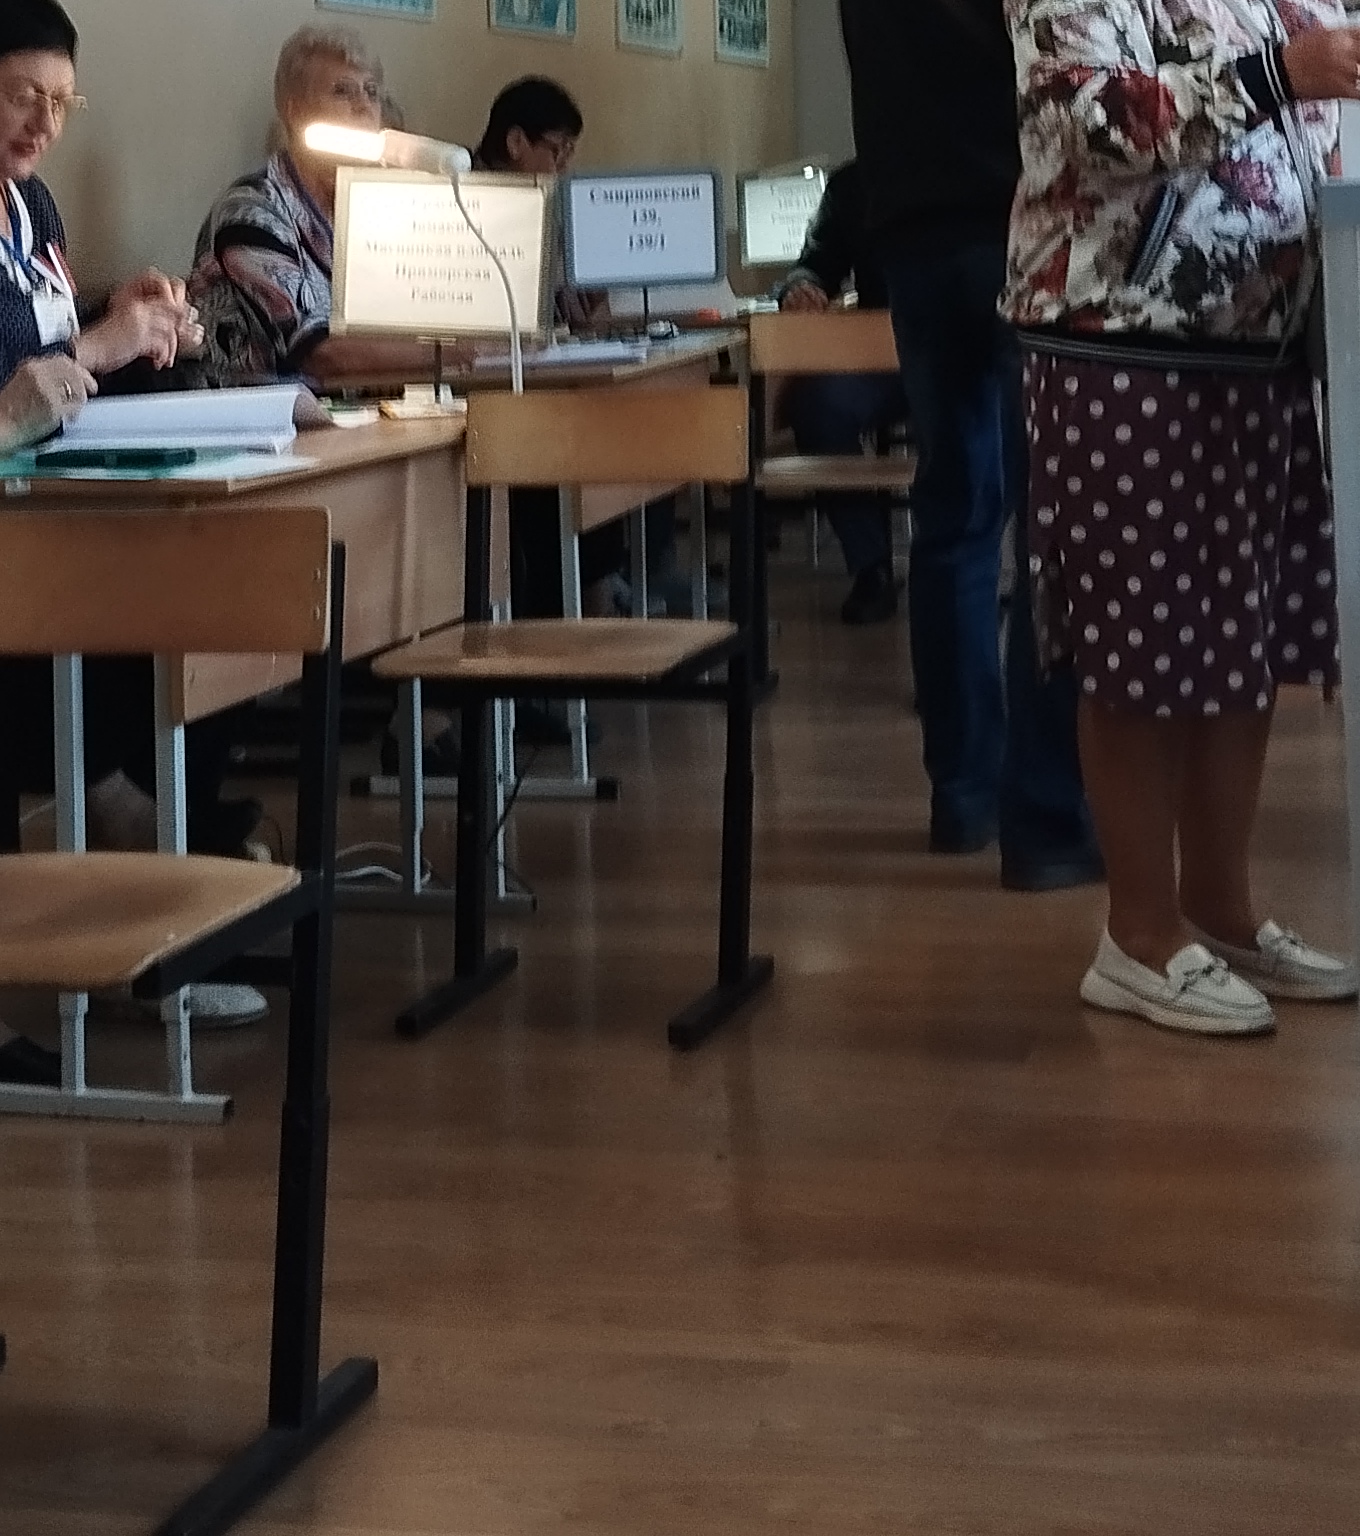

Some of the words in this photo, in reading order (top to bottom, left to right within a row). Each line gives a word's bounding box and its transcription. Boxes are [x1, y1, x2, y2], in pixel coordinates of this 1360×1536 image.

[589, 184, 700, 207] Смирновский
[395, 262, 491, 282] Приморская
[411, 286, 474, 304] Рабочая
